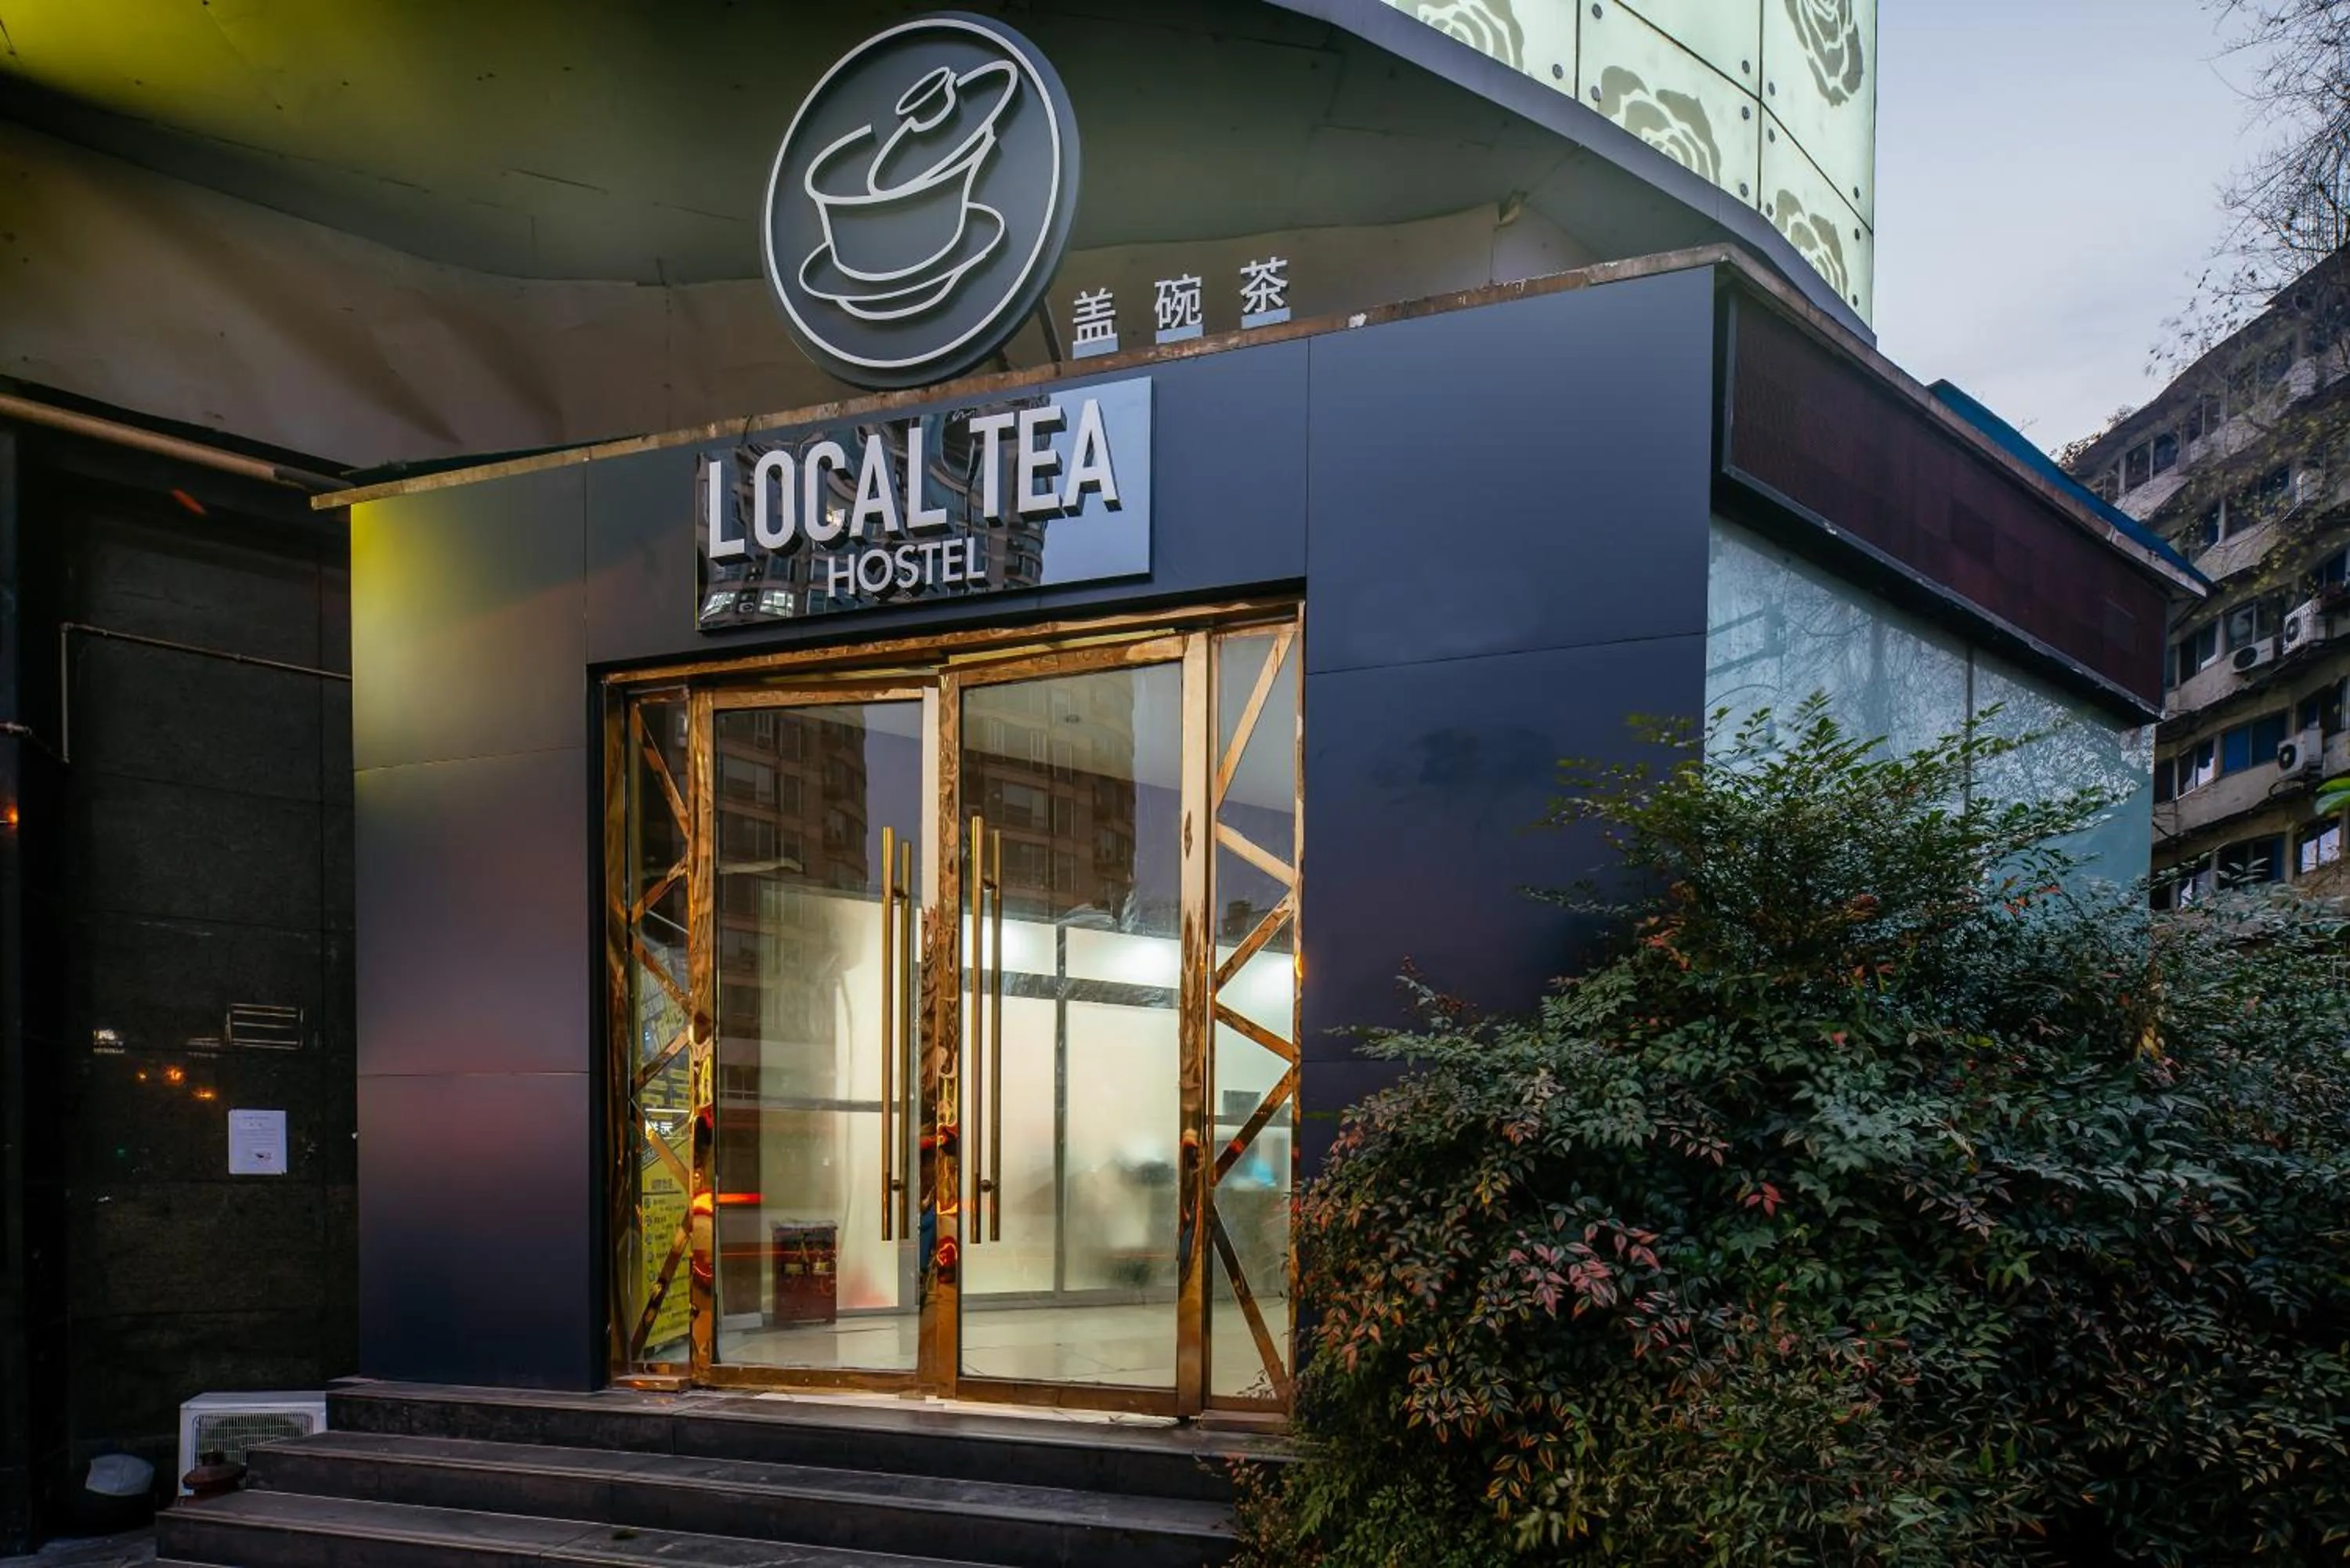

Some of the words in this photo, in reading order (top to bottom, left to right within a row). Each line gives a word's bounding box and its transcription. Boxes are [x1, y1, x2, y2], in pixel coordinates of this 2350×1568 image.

[1072, 256, 1289, 345] 盖碗茶
[709, 427, 947, 558] LOCAL
[969, 399, 1119, 514] TEA
[828, 537, 985, 598] HOSTEL
